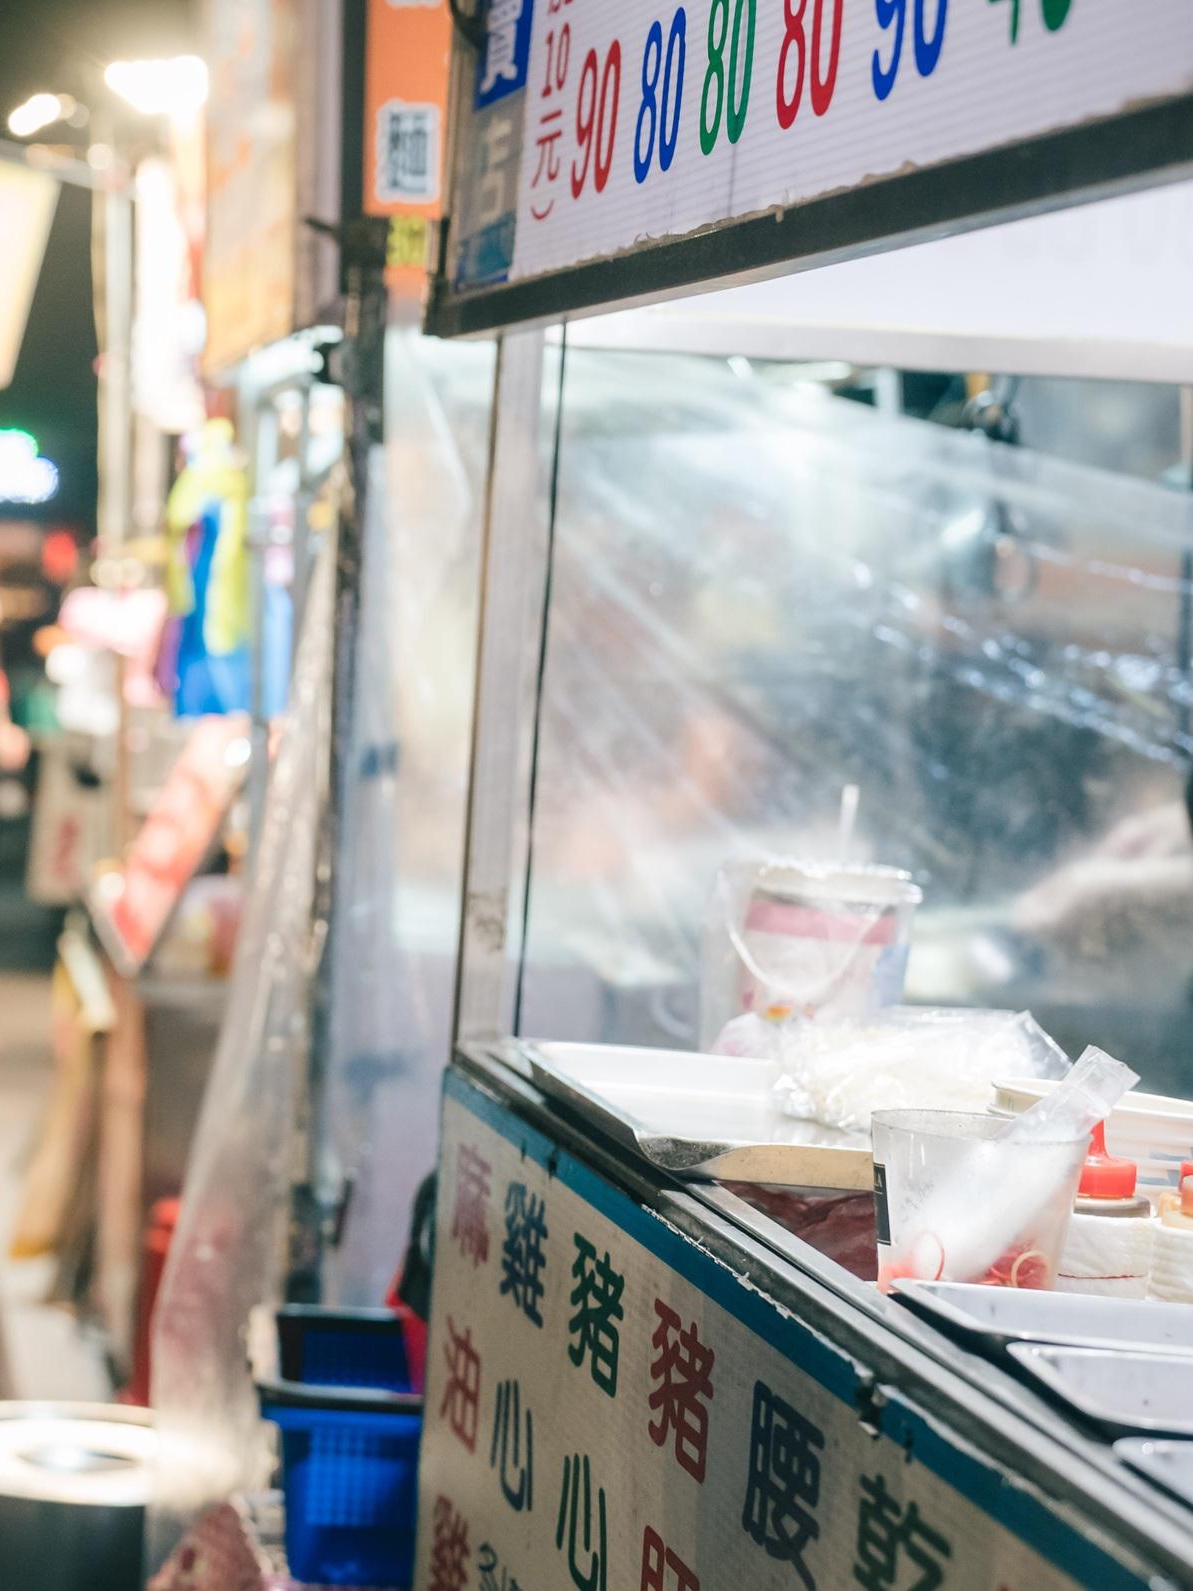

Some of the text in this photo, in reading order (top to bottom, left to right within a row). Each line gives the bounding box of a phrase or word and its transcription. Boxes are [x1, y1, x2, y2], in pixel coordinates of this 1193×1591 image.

[570, 39, 621, 200] 90
[634, 6, 687, 184] 80
[699, 0, 757, 156] 80
[776, 0, 843, 130] 80
[557, 1232, 625, 1591] 豬心
